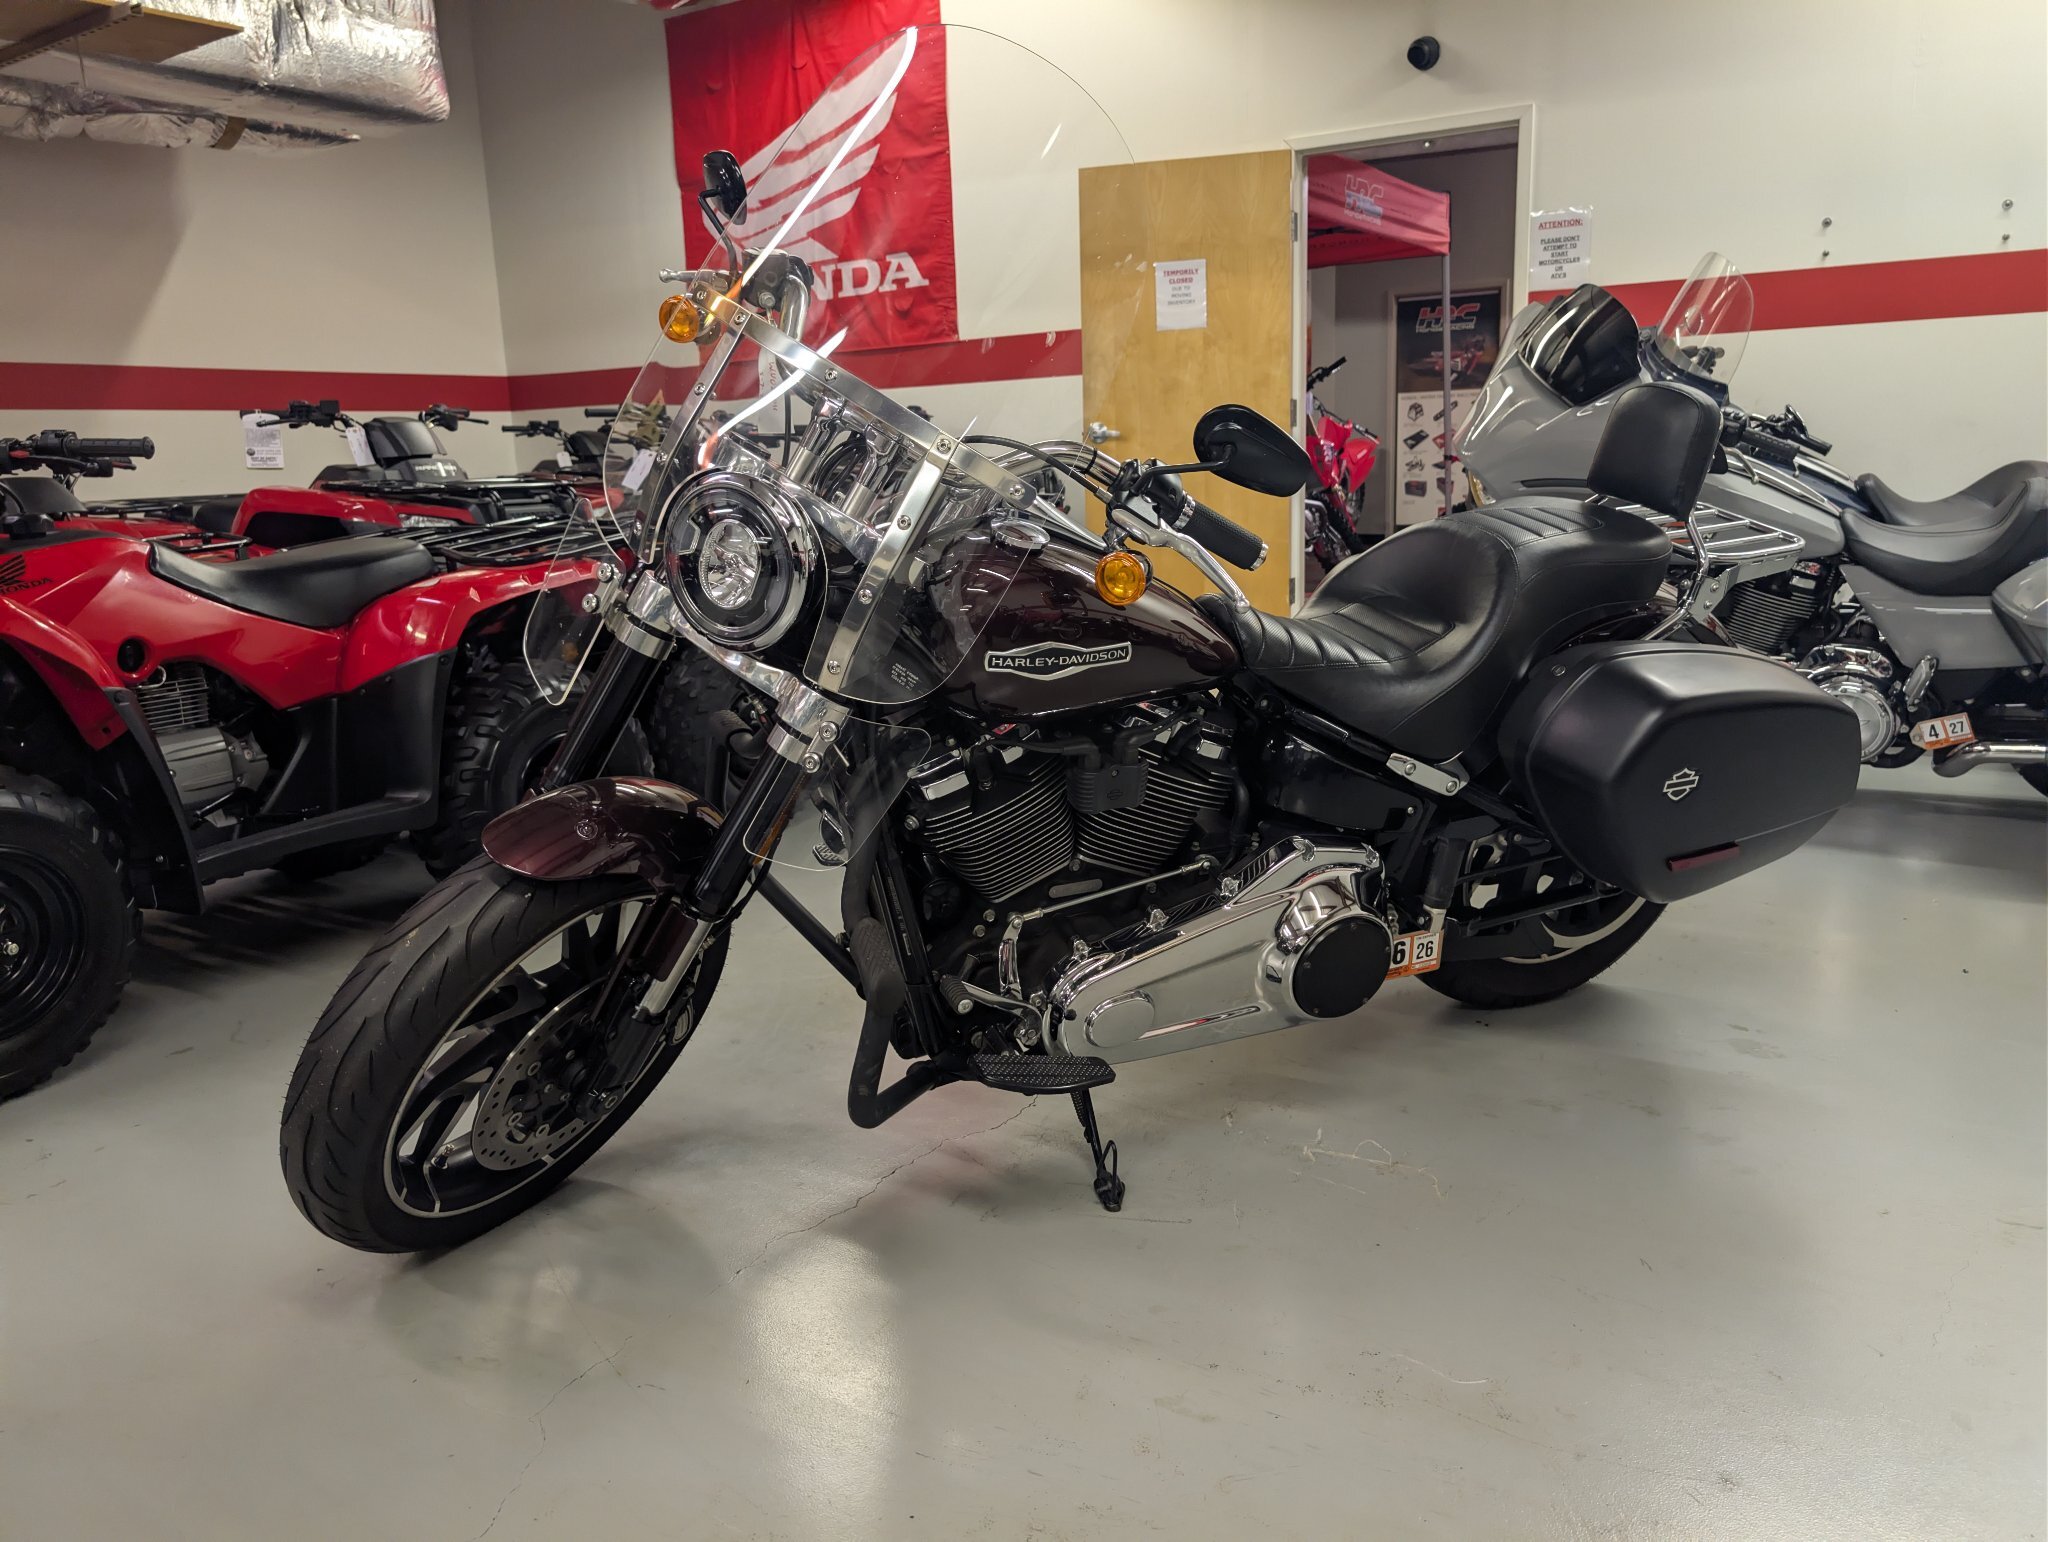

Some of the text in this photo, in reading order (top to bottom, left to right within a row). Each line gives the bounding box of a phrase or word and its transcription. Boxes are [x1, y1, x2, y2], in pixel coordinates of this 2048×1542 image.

[1538, 218, 1583, 230] ATTENTION:
[1541, 236, 1562, 245] PLEASE
[1543, 244, 1569, 252] ATTEMPT
[1539, 257, 1580, 266] MOTORCYCLES
[811, 252, 929, 300] NDA
[1169, 277, 1193, 285] CLOSED
[991, 648, 1127, 667] HARLEY-DAVIDSON
[1929, 720, 1964, 739] 4 27
[1392, 941, 1406, 966] 6
[1416, 940, 1434, 960] 26
